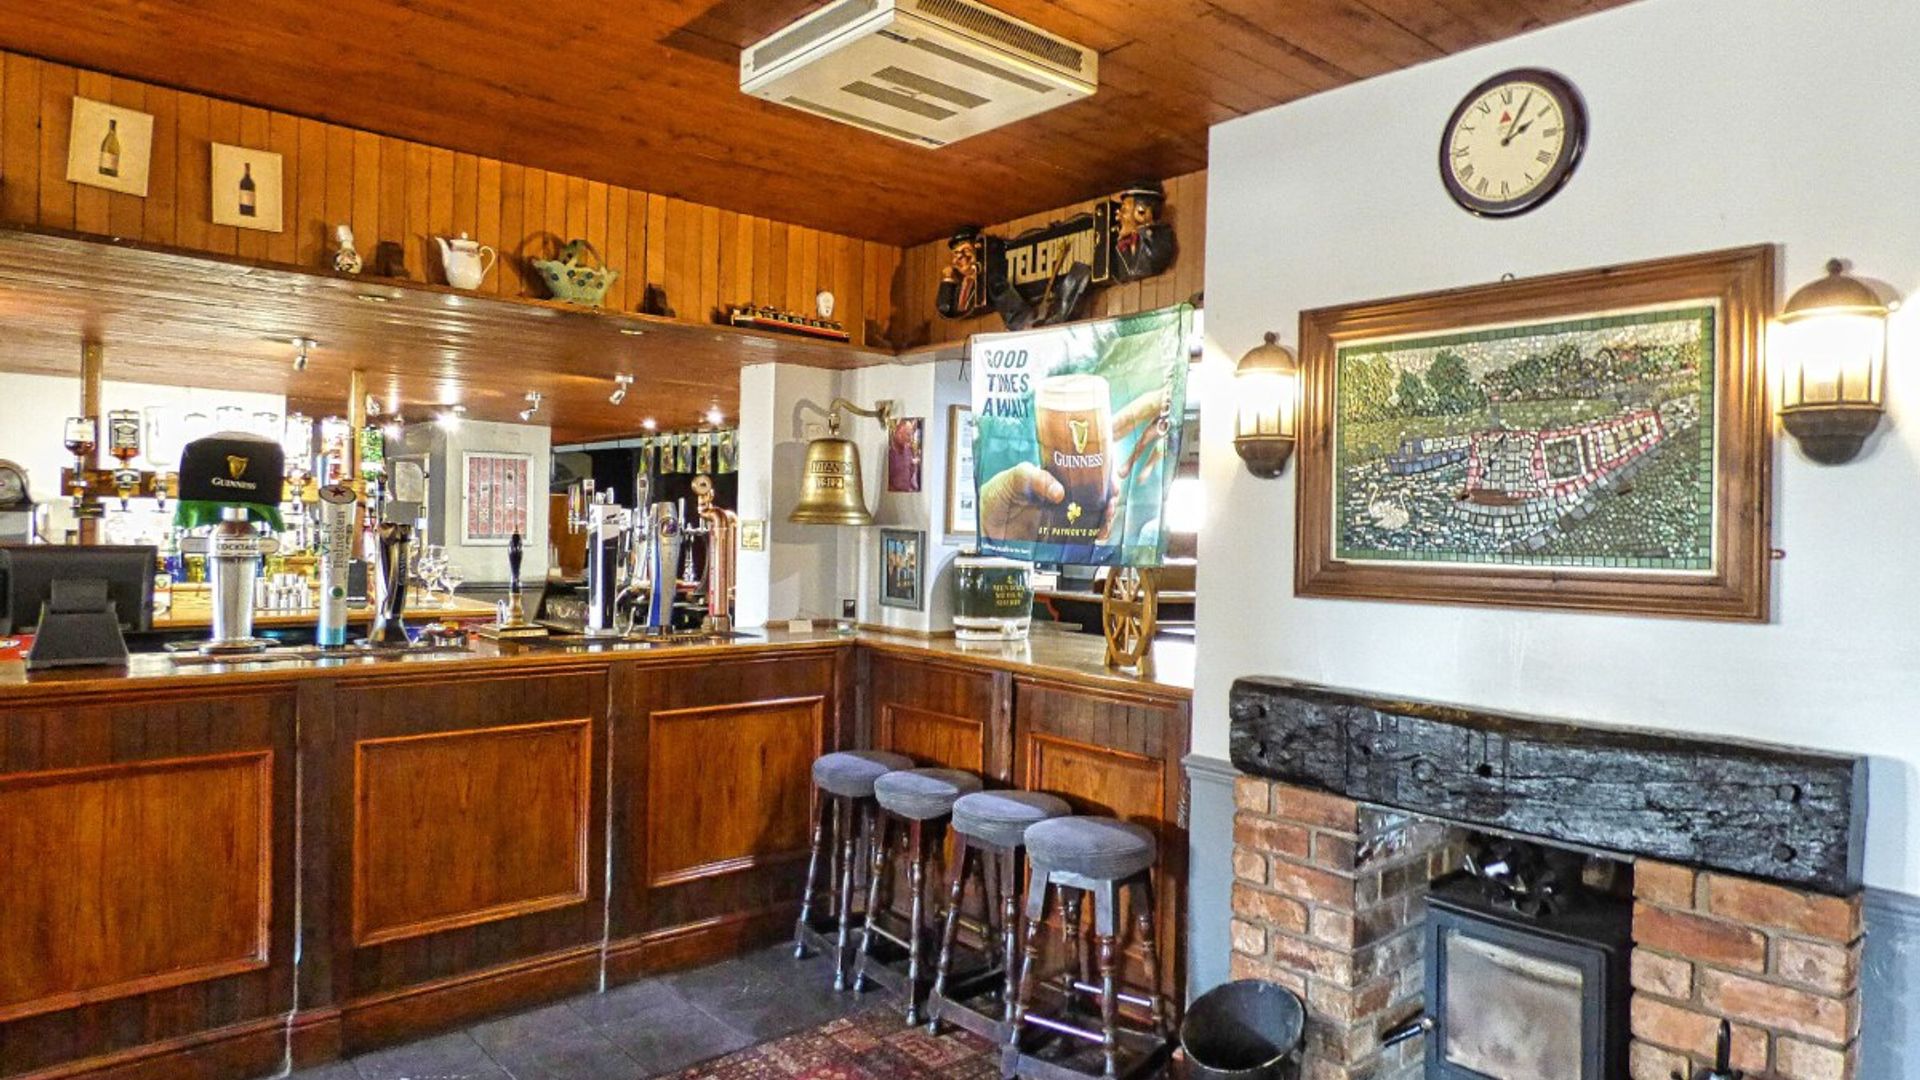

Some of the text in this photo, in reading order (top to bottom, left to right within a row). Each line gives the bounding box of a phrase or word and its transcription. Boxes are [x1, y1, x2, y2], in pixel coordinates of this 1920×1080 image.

[1054, 450, 1104, 469] GUINNESS
[211, 476, 257, 491] GUINNESS
[332, 511, 346, 569] Heineken
